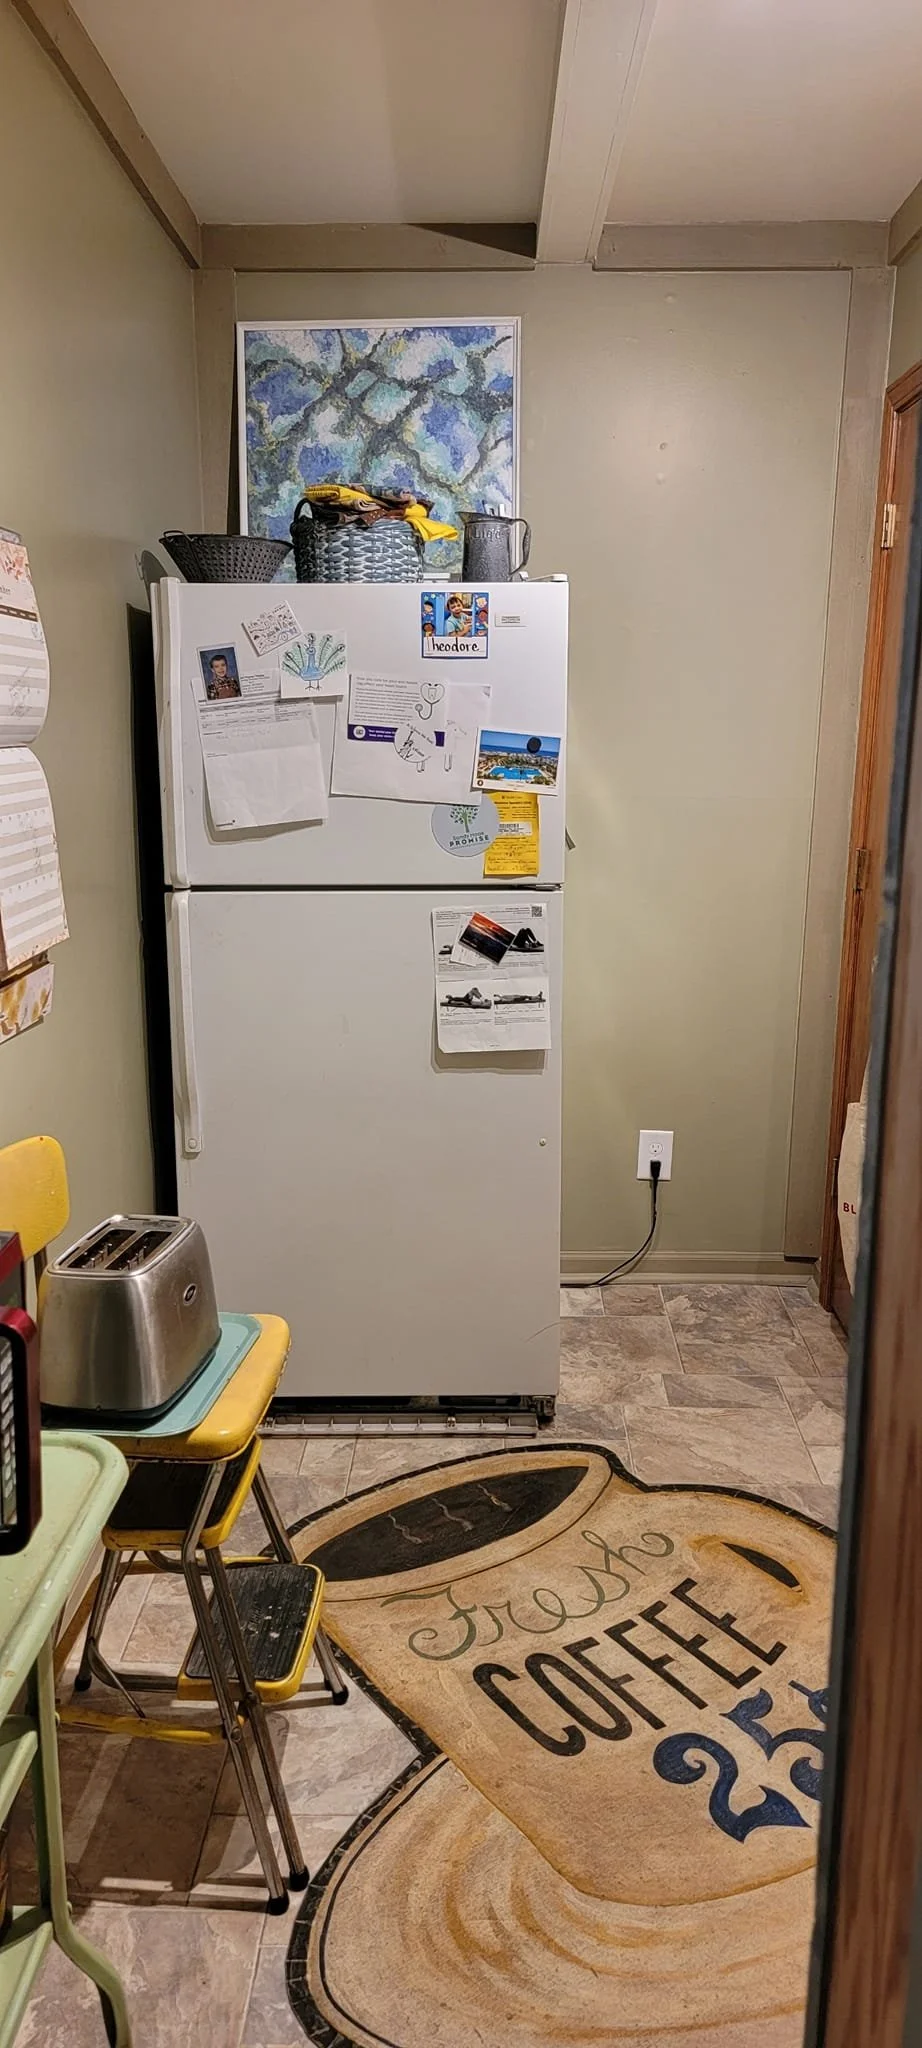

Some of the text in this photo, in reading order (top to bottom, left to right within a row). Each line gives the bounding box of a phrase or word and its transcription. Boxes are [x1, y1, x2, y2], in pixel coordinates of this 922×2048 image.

[449, 834, 490, 848] PROMISE
[843, 1202, 857, 1215] BL
[380, 1530, 675, 1661] Fresh
[472, 1577, 788, 1757] COFFEE
